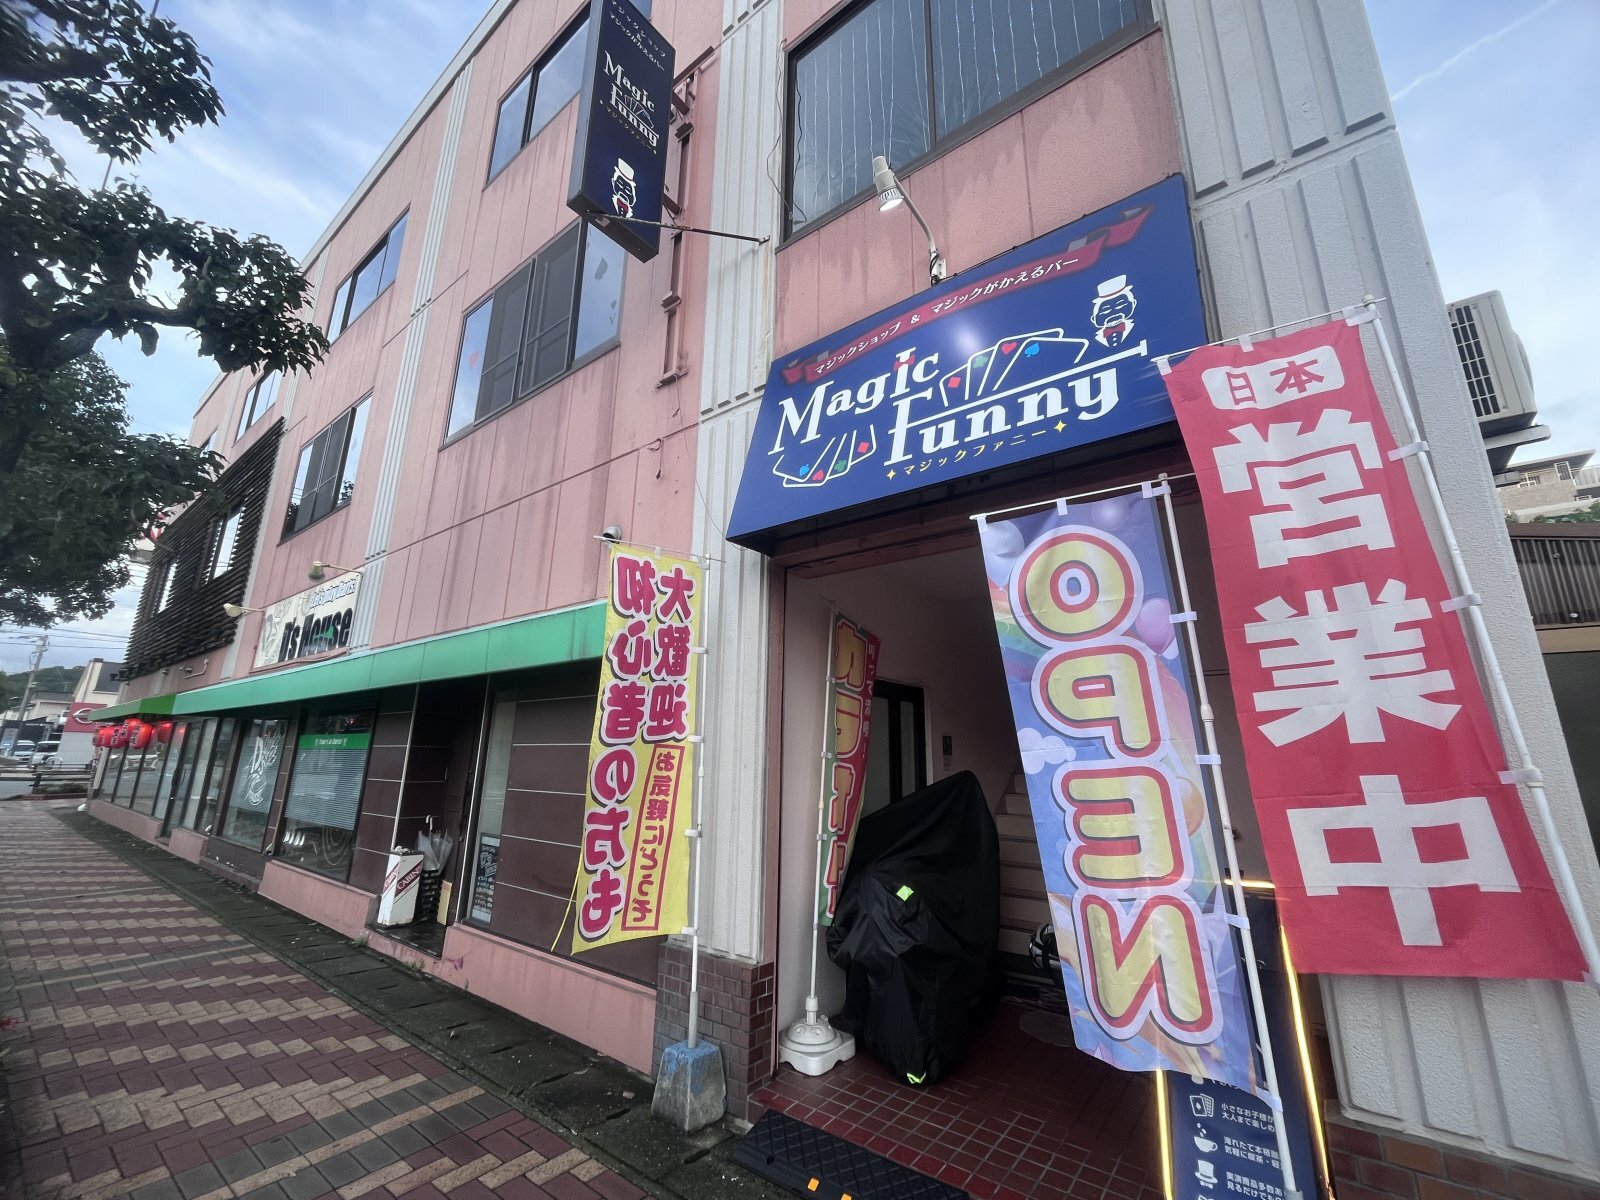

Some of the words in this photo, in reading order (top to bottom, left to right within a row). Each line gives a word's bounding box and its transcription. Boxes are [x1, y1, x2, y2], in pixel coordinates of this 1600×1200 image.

[603, 50, 655, 112] Magic
[609, 83, 660, 147] Funny
[814, 320, 902, 375] マジックショップ
[909, 313, 922, 325] &
[930, 257, 1080, 314] マジックがかえるバー
[767, 346, 941, 456] Magic
[883, 340, 1148, 468] Funny
[1227, 359, 1326, 406] 日本
[902, 428, 1048, 477] マジックファニー
[297, 608, 353, 658] House
[1212, 408, 1521, 948] 営業中
